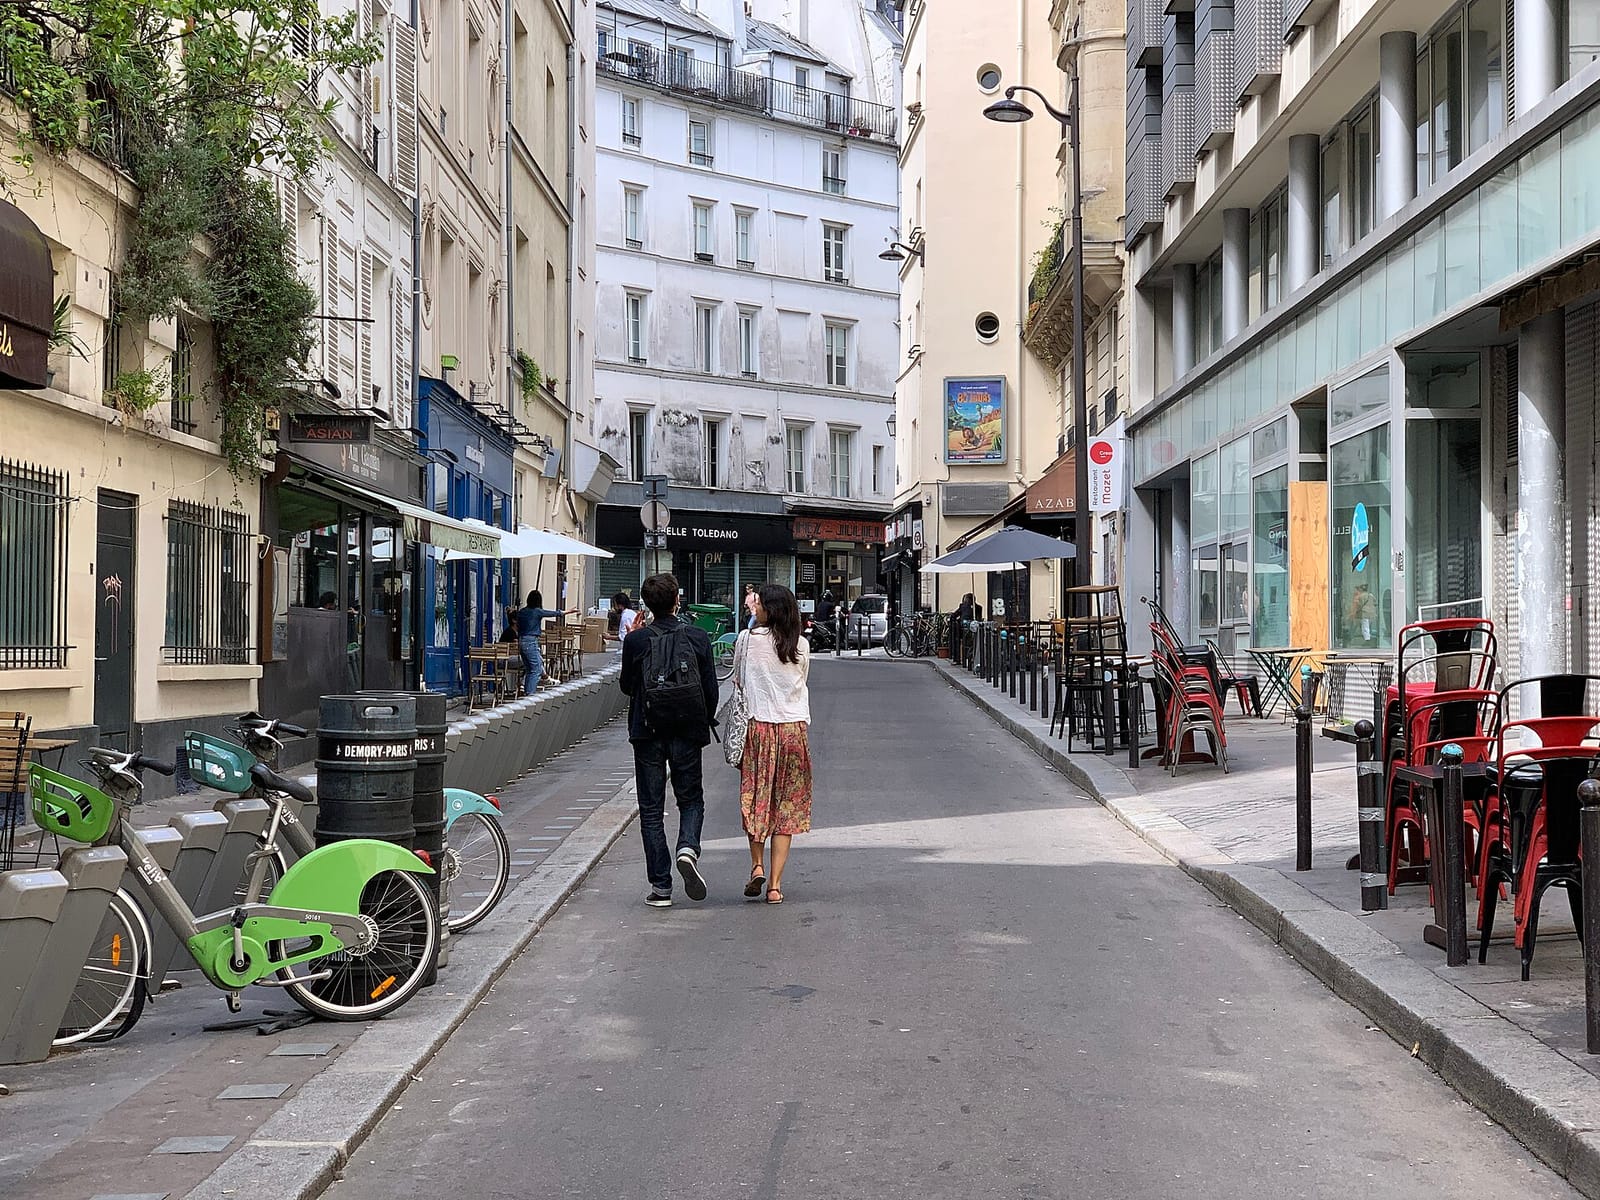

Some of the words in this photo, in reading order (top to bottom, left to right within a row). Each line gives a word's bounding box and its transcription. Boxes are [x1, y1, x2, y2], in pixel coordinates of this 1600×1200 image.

[306, 428, 353, 440] ASIAN
[1035, 498, 1075, 509] AZAB
[691, 527, 739, 540] TOLEDANO
[344, 744, 408, 758] DEMORY-PARIS
